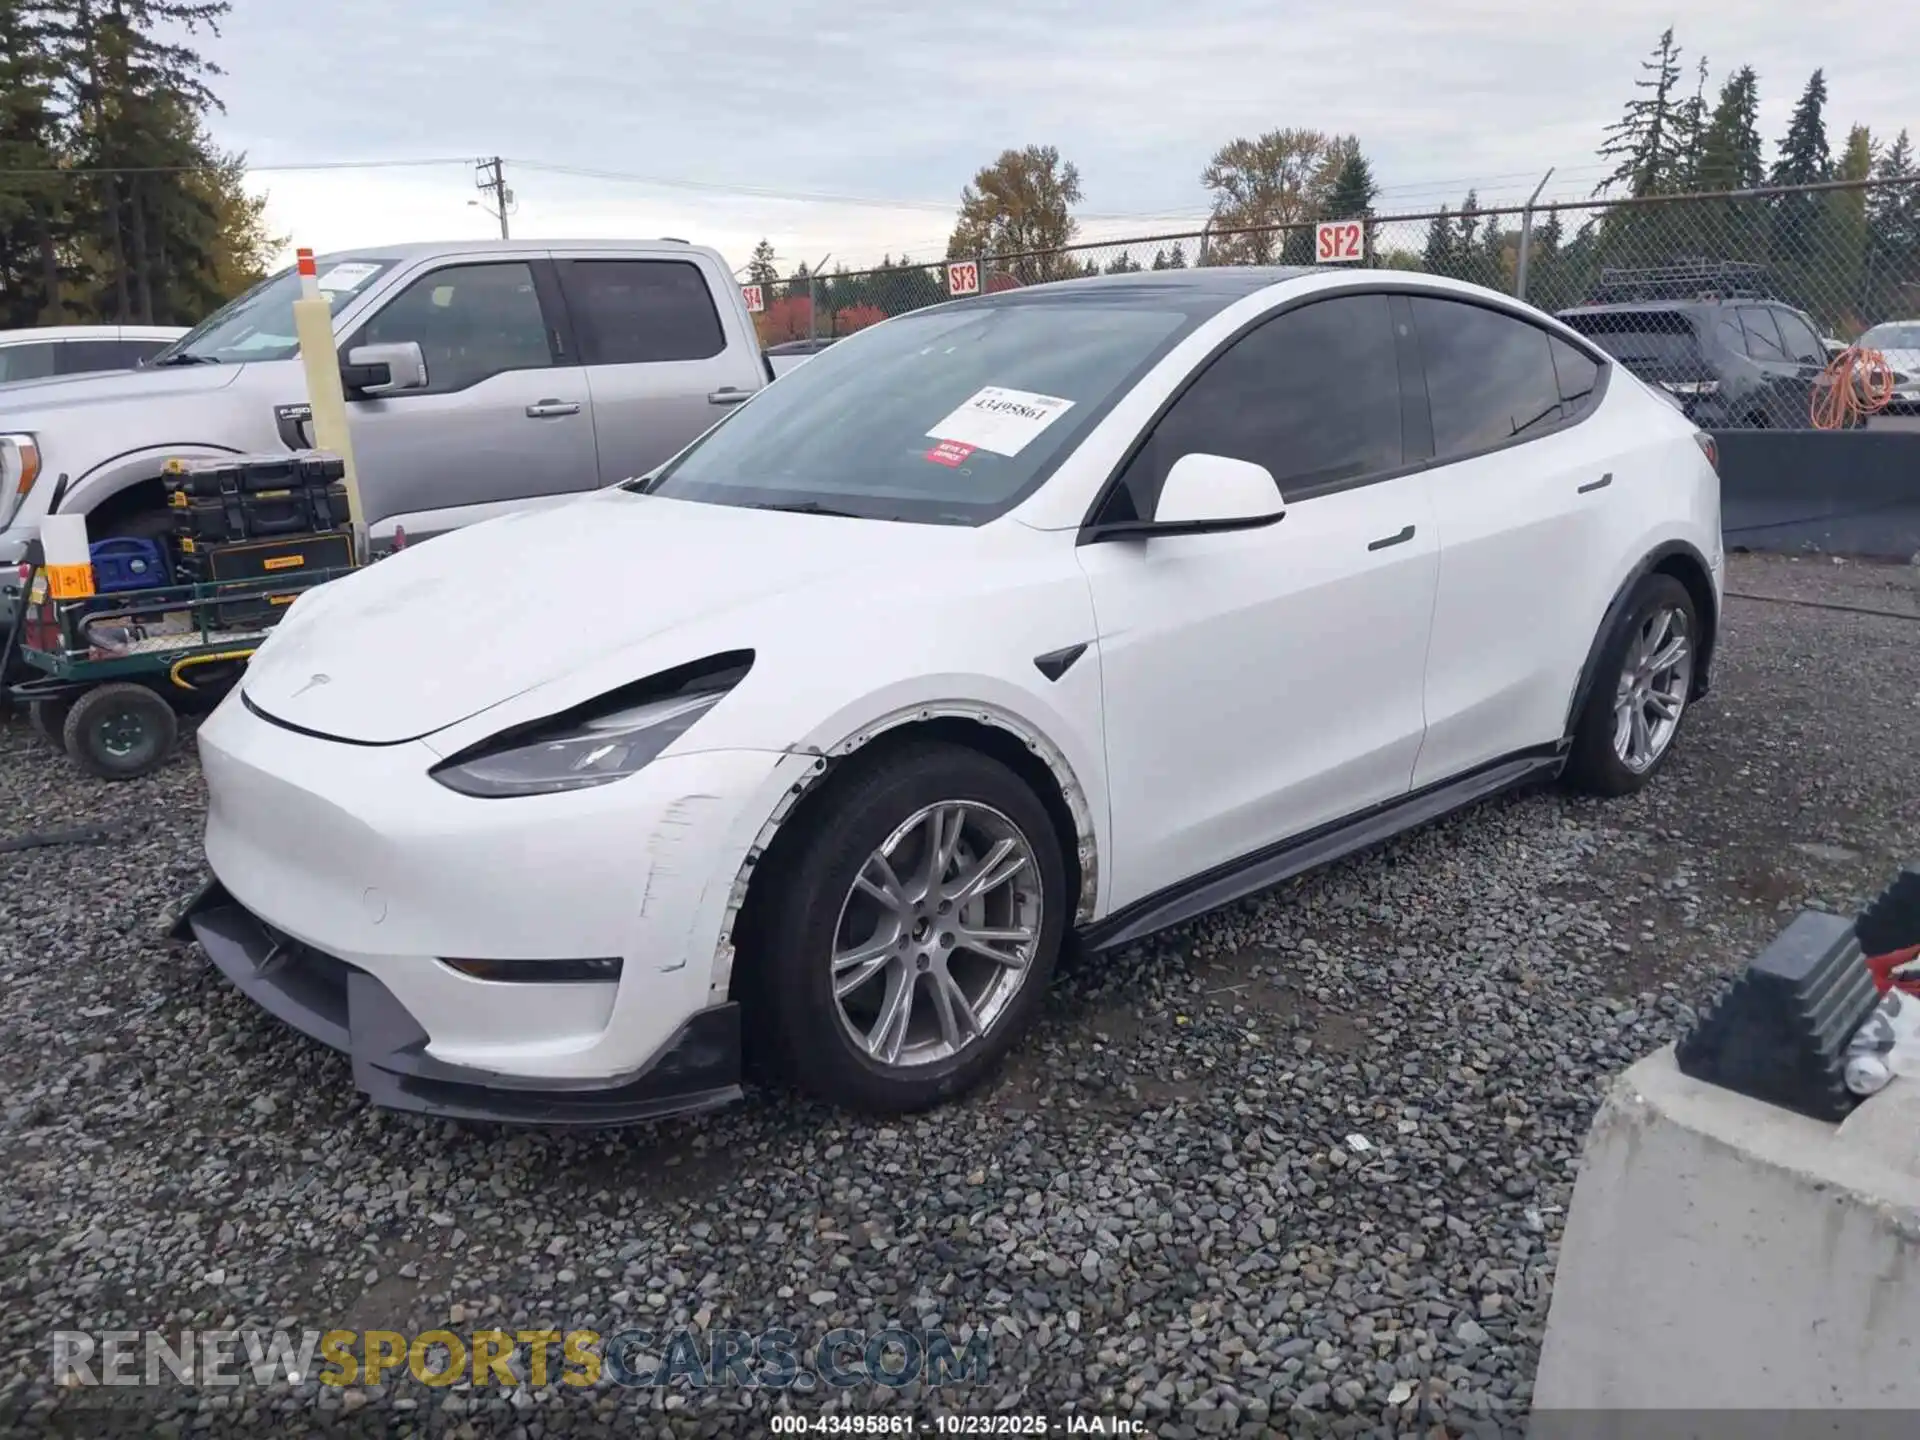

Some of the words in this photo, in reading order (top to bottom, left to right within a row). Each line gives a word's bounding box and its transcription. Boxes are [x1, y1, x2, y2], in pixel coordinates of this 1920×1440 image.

[1319, 224, 1360, 258] SF2
[951, 264, 976, 290] SF3
[743, 287, 761, 310] SF4
[973, 398, 1048, 420] 43495861
